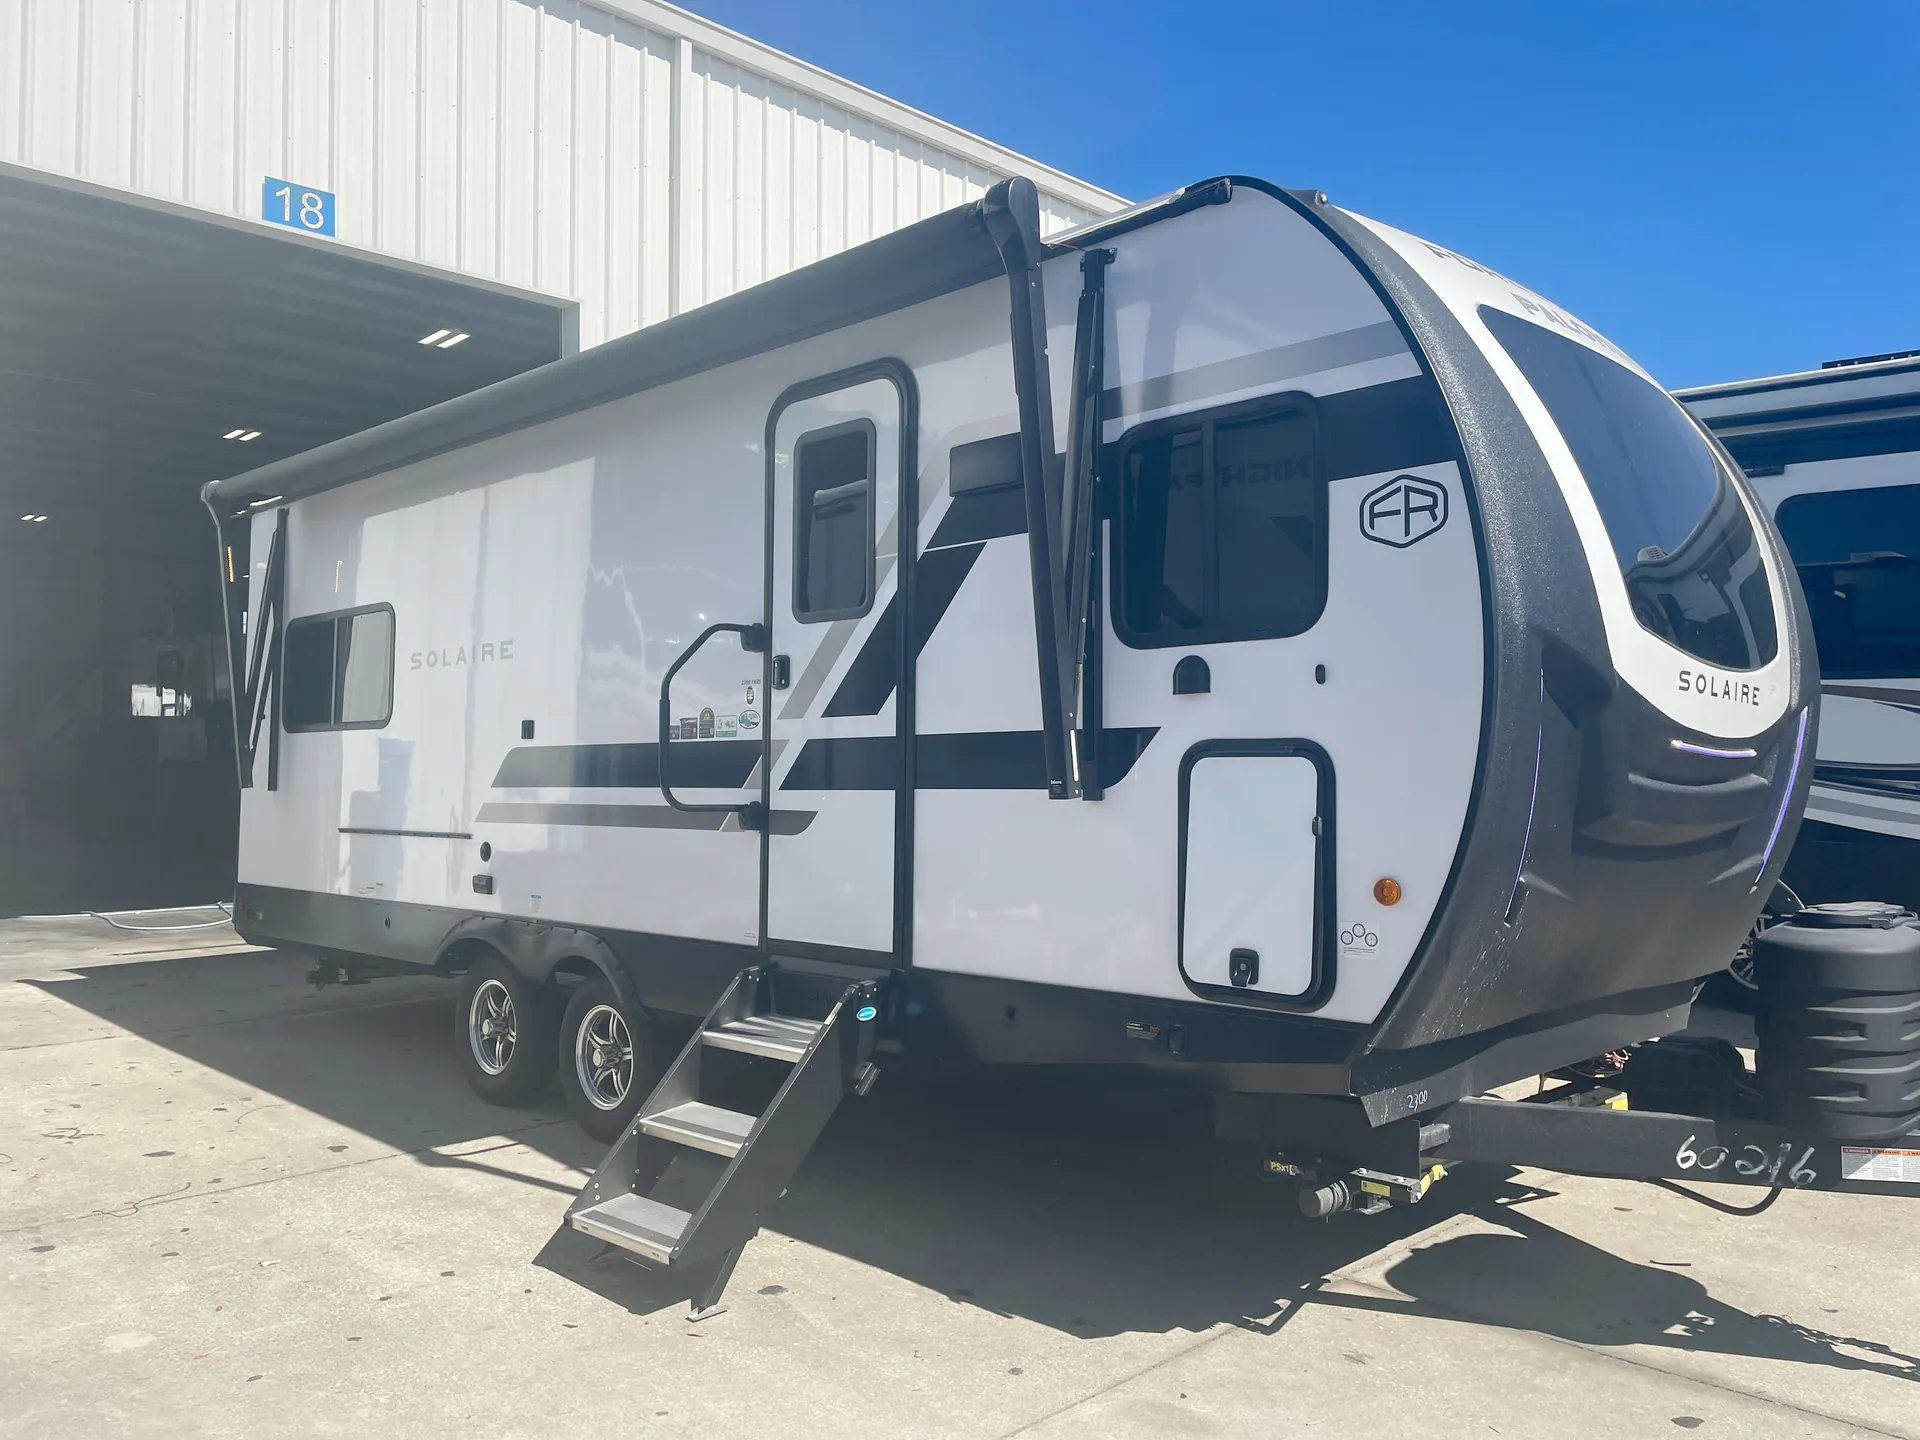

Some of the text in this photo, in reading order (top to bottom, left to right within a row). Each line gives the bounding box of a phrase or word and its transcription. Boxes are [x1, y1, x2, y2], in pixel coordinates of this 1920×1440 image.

[275, 186, 324, 229] 18
[410, 639, 514, 670] SOLAIRE
[1678, 670, 1760, 707] SOLAIRE
